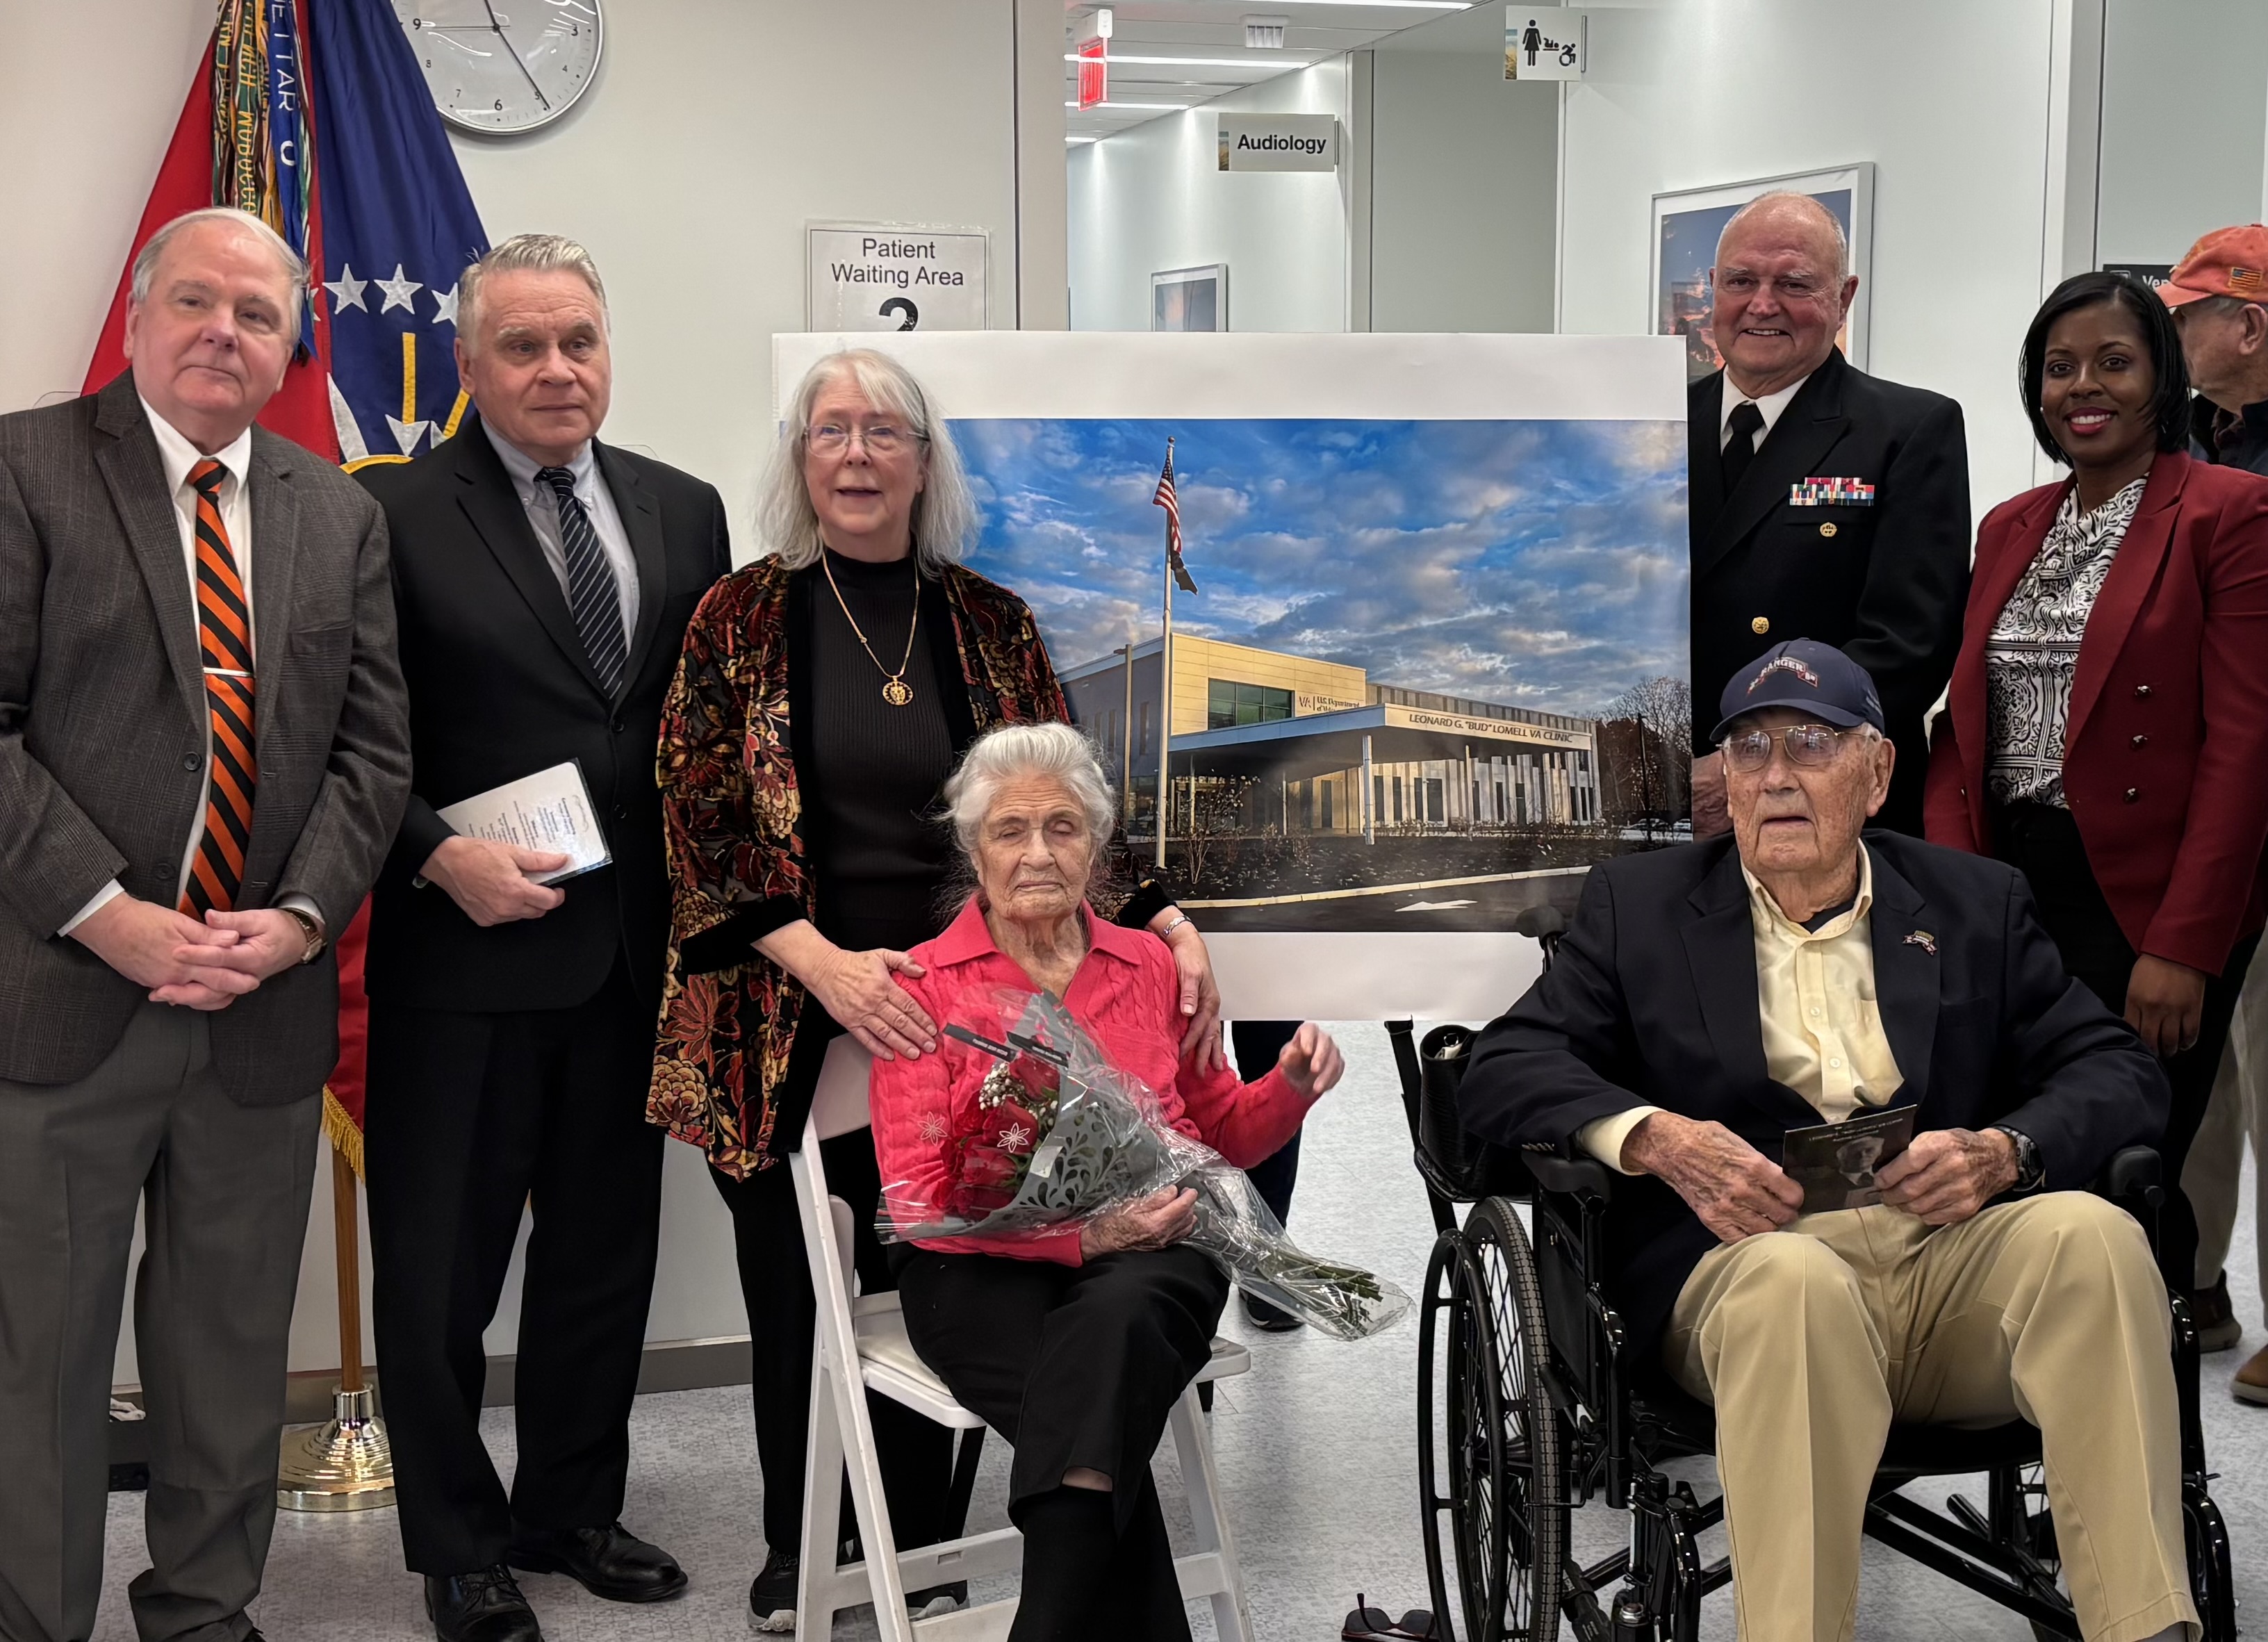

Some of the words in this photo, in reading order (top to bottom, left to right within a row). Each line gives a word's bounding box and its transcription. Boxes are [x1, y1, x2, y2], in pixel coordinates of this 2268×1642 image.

[413, 18, 422, 30] 9
[570, 24, 579, 36] 3
[425, 60, 432, 68] 8
[455, 88, 462, 98] 7
[494, 99, 503, 110] 6
[1237, 133, 1326, 154] Audiology
[862, 238, 936, 259] Patient
[831, 263, 909, 289] Waiting
[914, 266, 964, 286] Area
[1409, 714, 1453, 727] LEONARD
[1454, 720, 1464, 729] G.
[1493, 725, 1528, 737] LOMELL
[1529, 729, 1541, 739] VA
[1543, 731, 1573, 743] CLINIC
